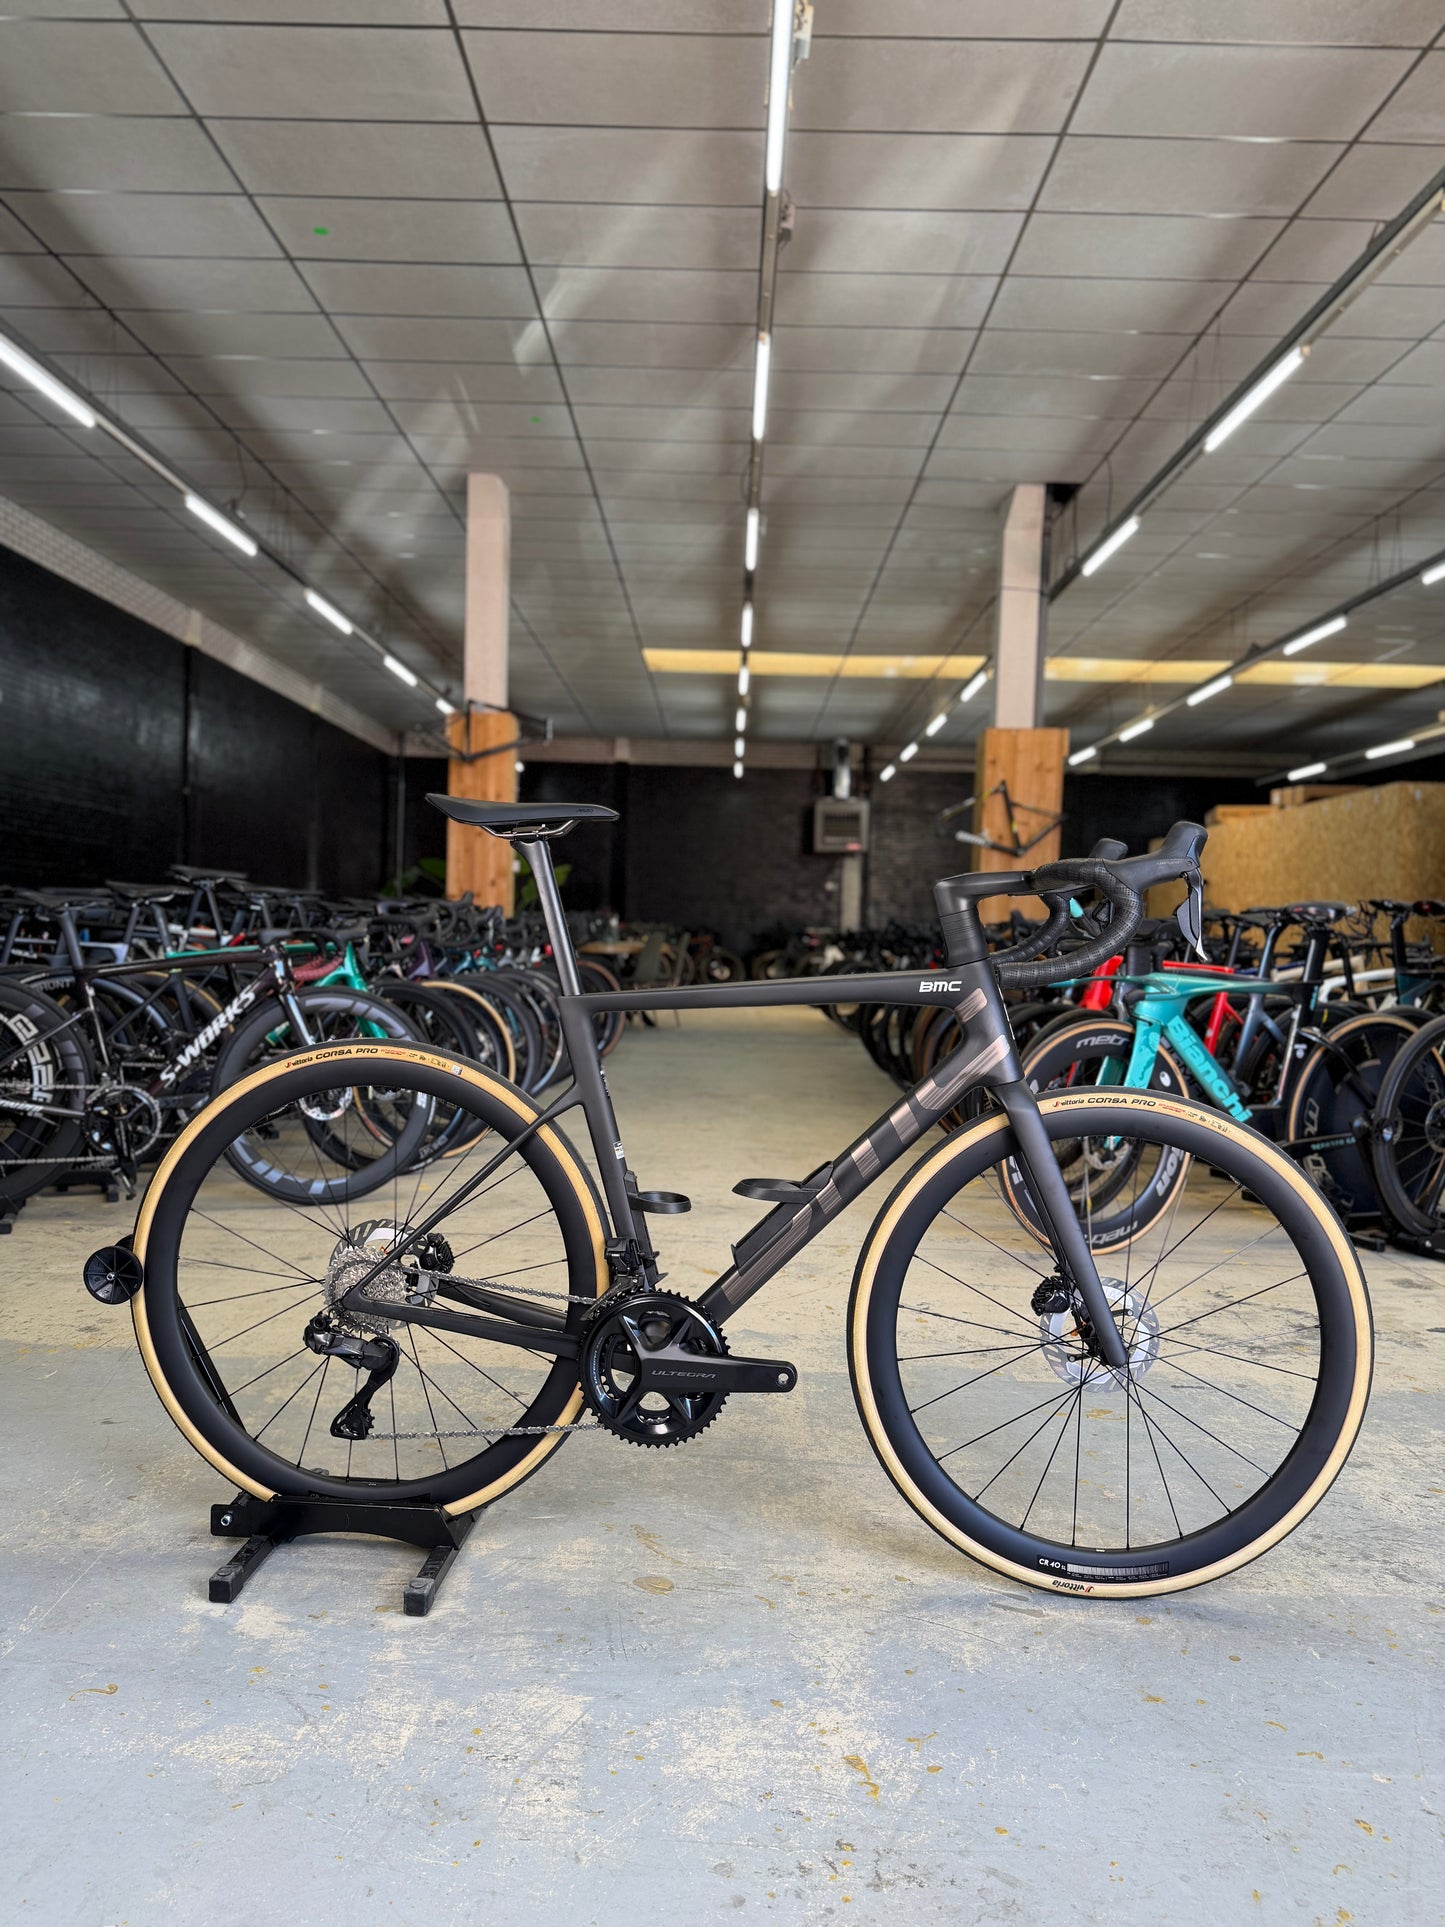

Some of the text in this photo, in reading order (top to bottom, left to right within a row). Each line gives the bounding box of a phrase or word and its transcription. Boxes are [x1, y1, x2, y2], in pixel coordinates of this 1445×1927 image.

[919, 981, 962, 993] BMC
[160, 982, 260, 1088] S-WORKS
[1076, 1034, 1129, 1049] metr
[292, 1056, 314, 1066] vittoria
[315, 1049, 353, 1060] CORSA
[355, 1047, 379, 1055] PRO
[1167, 1015, 1253, 1123] Bianchi
[1060, 1097, 1157, 1107] vittoria CORSA PRO
[651, 1370, 717, 1379] ULTEGRA
[1038, 1558, 1049, 1567] CR
[1049, 1561, 1061, 1569] 40
[1051, 1579, 1085, 1593] vittoria
